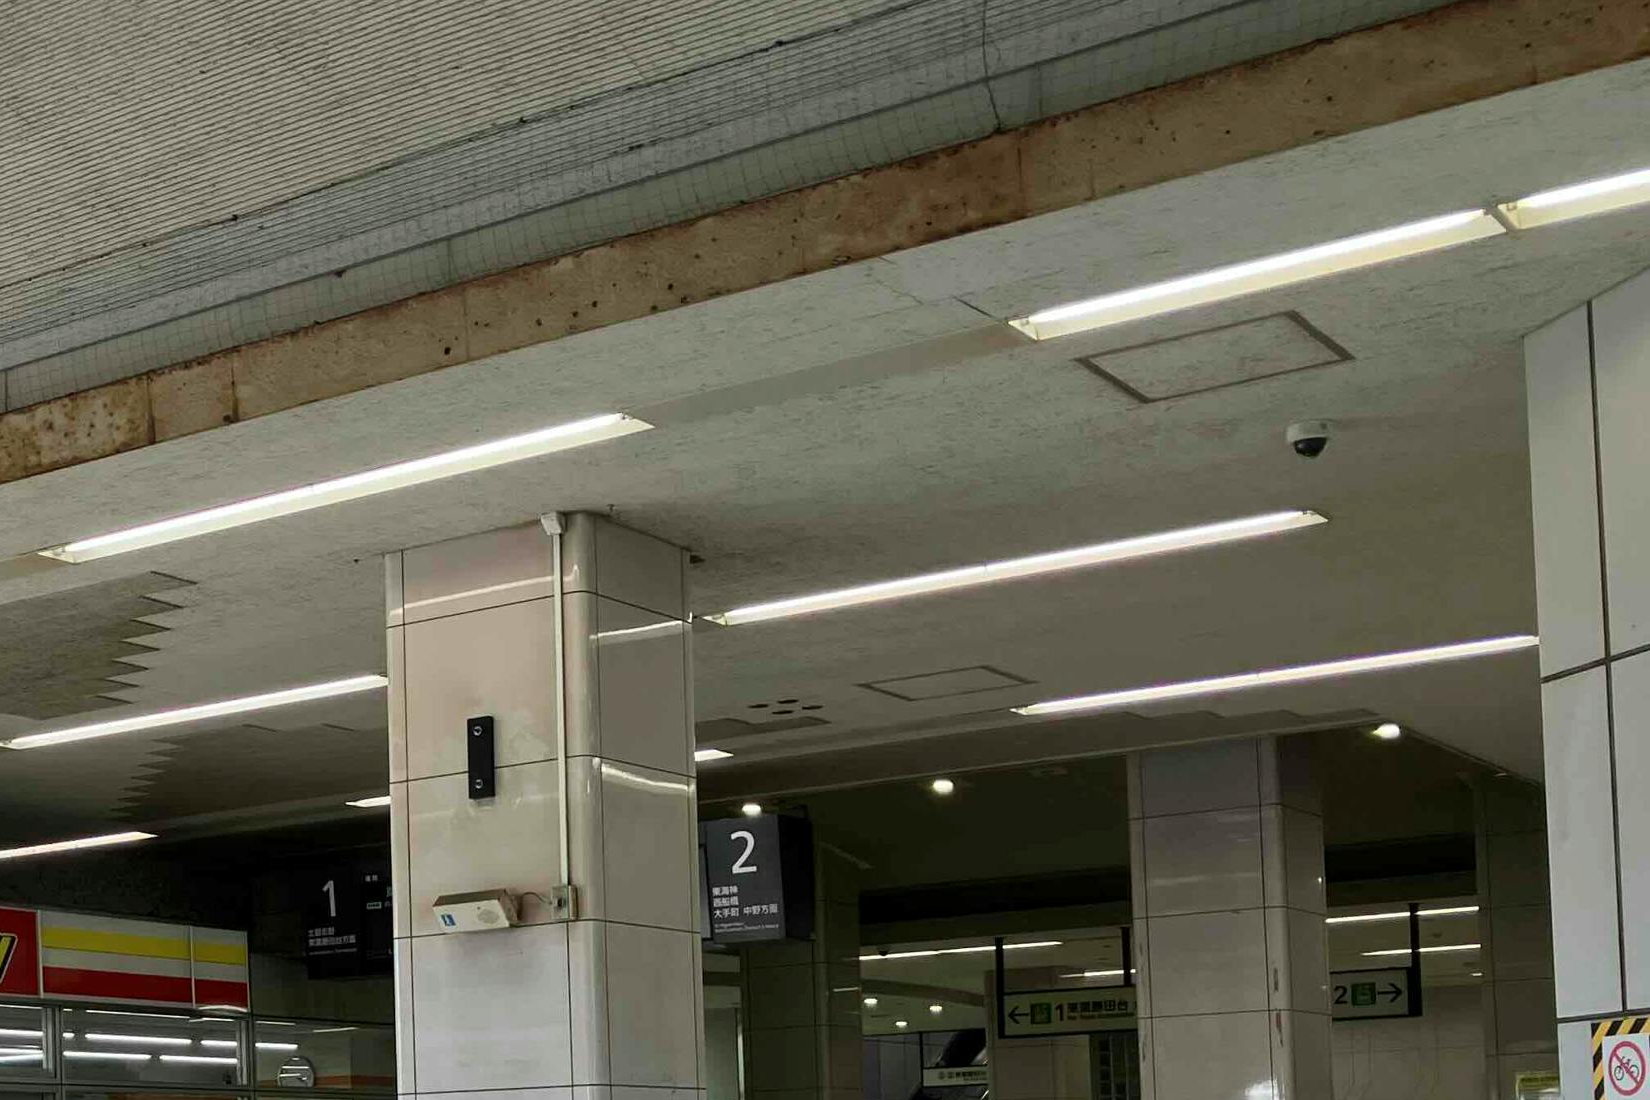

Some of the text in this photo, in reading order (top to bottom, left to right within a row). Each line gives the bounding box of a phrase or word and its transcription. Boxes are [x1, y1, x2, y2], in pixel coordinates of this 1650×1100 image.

[731, 830, 757, 874] 2
[322, 880, 336, 917] 1
[1334, 986, 1347, 1004] 2
[1055, 1004, 1064, 1021] 1
